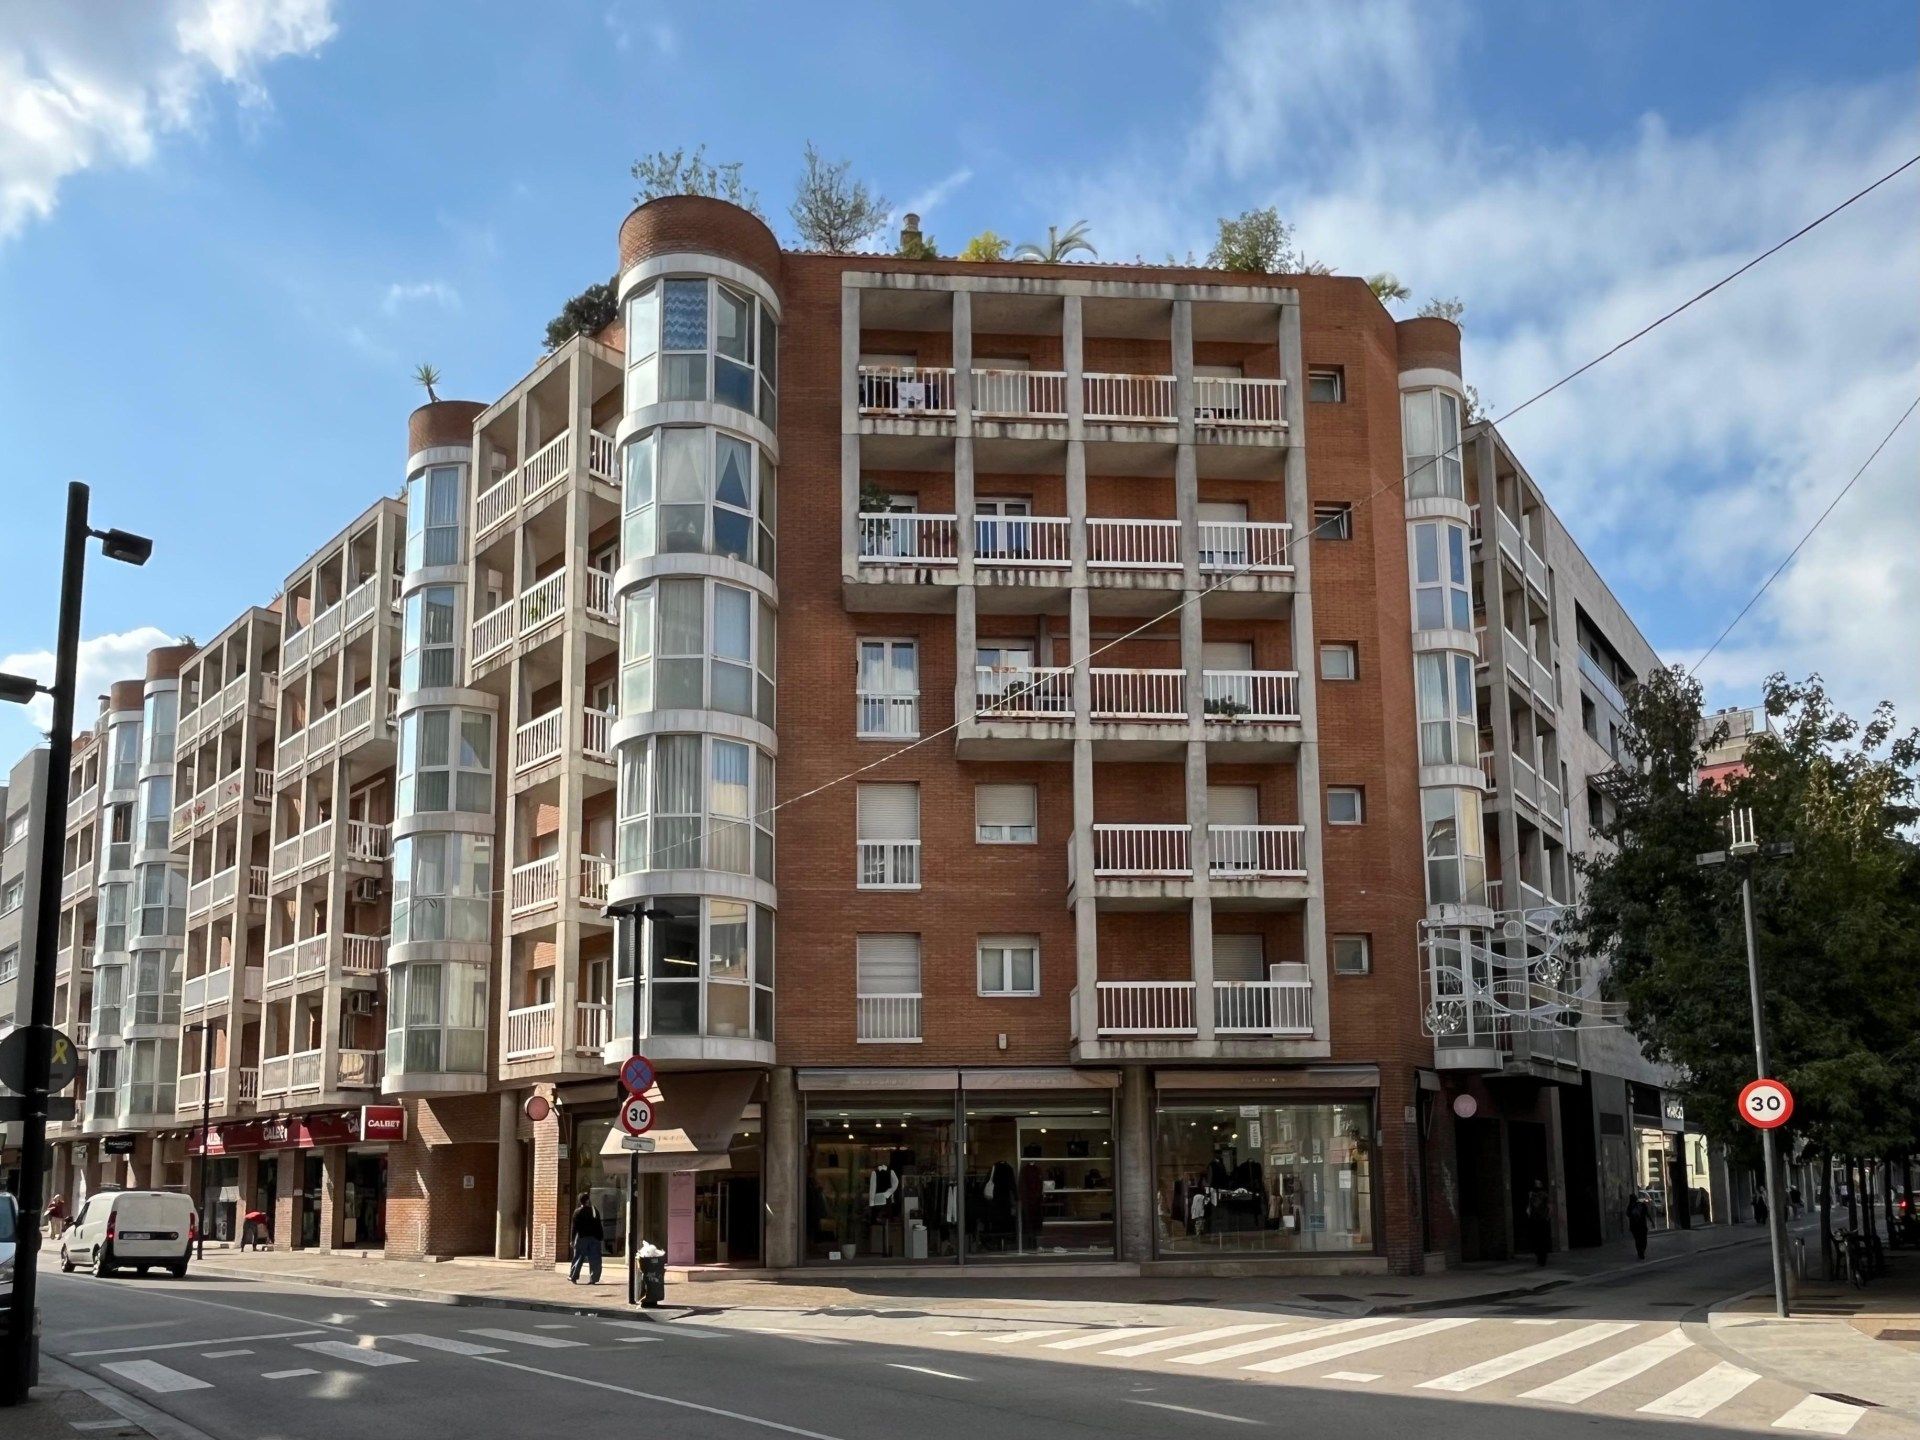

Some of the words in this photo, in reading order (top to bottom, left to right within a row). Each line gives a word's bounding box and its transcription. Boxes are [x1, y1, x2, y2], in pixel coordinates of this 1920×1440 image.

[1751, 1096, 1780, 1112] 30
[629, 1108, 648, 1122] 30
[367, 1119, 400, 1128] CALBET
